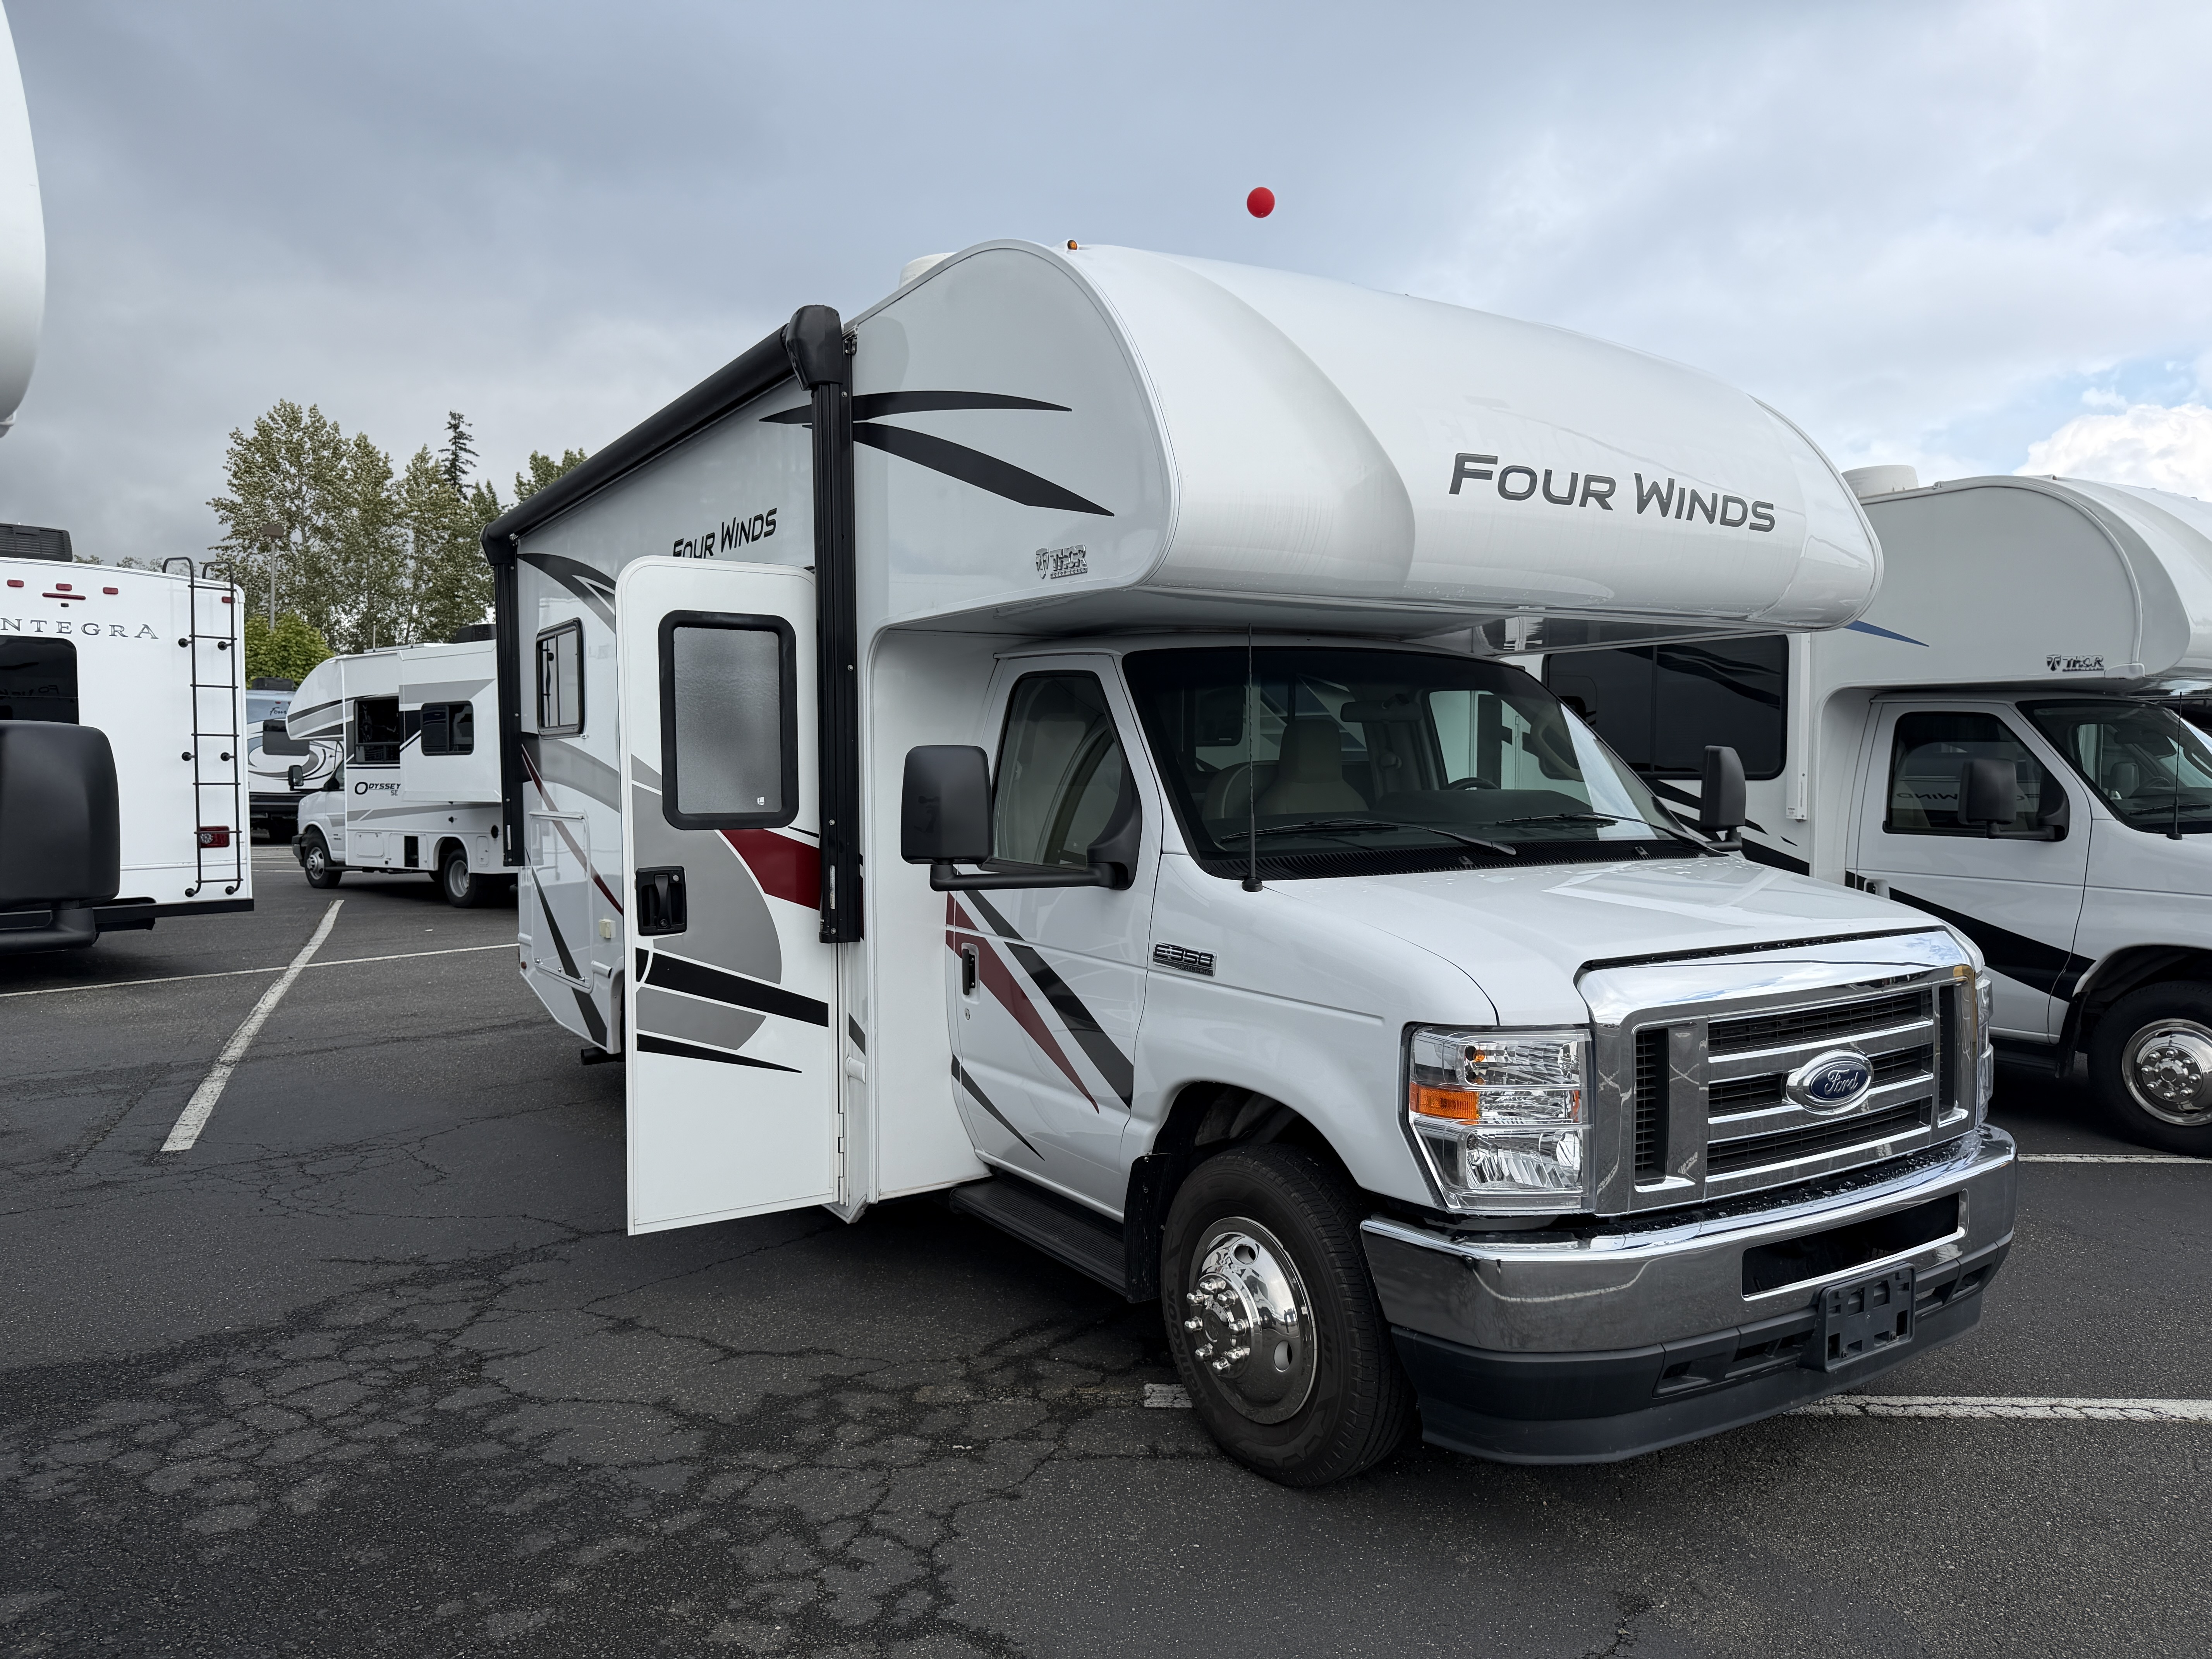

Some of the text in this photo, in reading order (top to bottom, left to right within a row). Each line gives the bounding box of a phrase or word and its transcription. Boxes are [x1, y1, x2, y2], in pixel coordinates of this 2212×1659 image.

[1449, 452, 1775, 532] FOUR WINDS
[673, 507, 777, 559] FOUR WINDS
[1050, 544, 1087, 571] THOR
[2063, 654, 2104, 668] THOR
[354, 782, 401, 795] ODYSSEY
[1824, 1068, 1858, 1095] Ford
